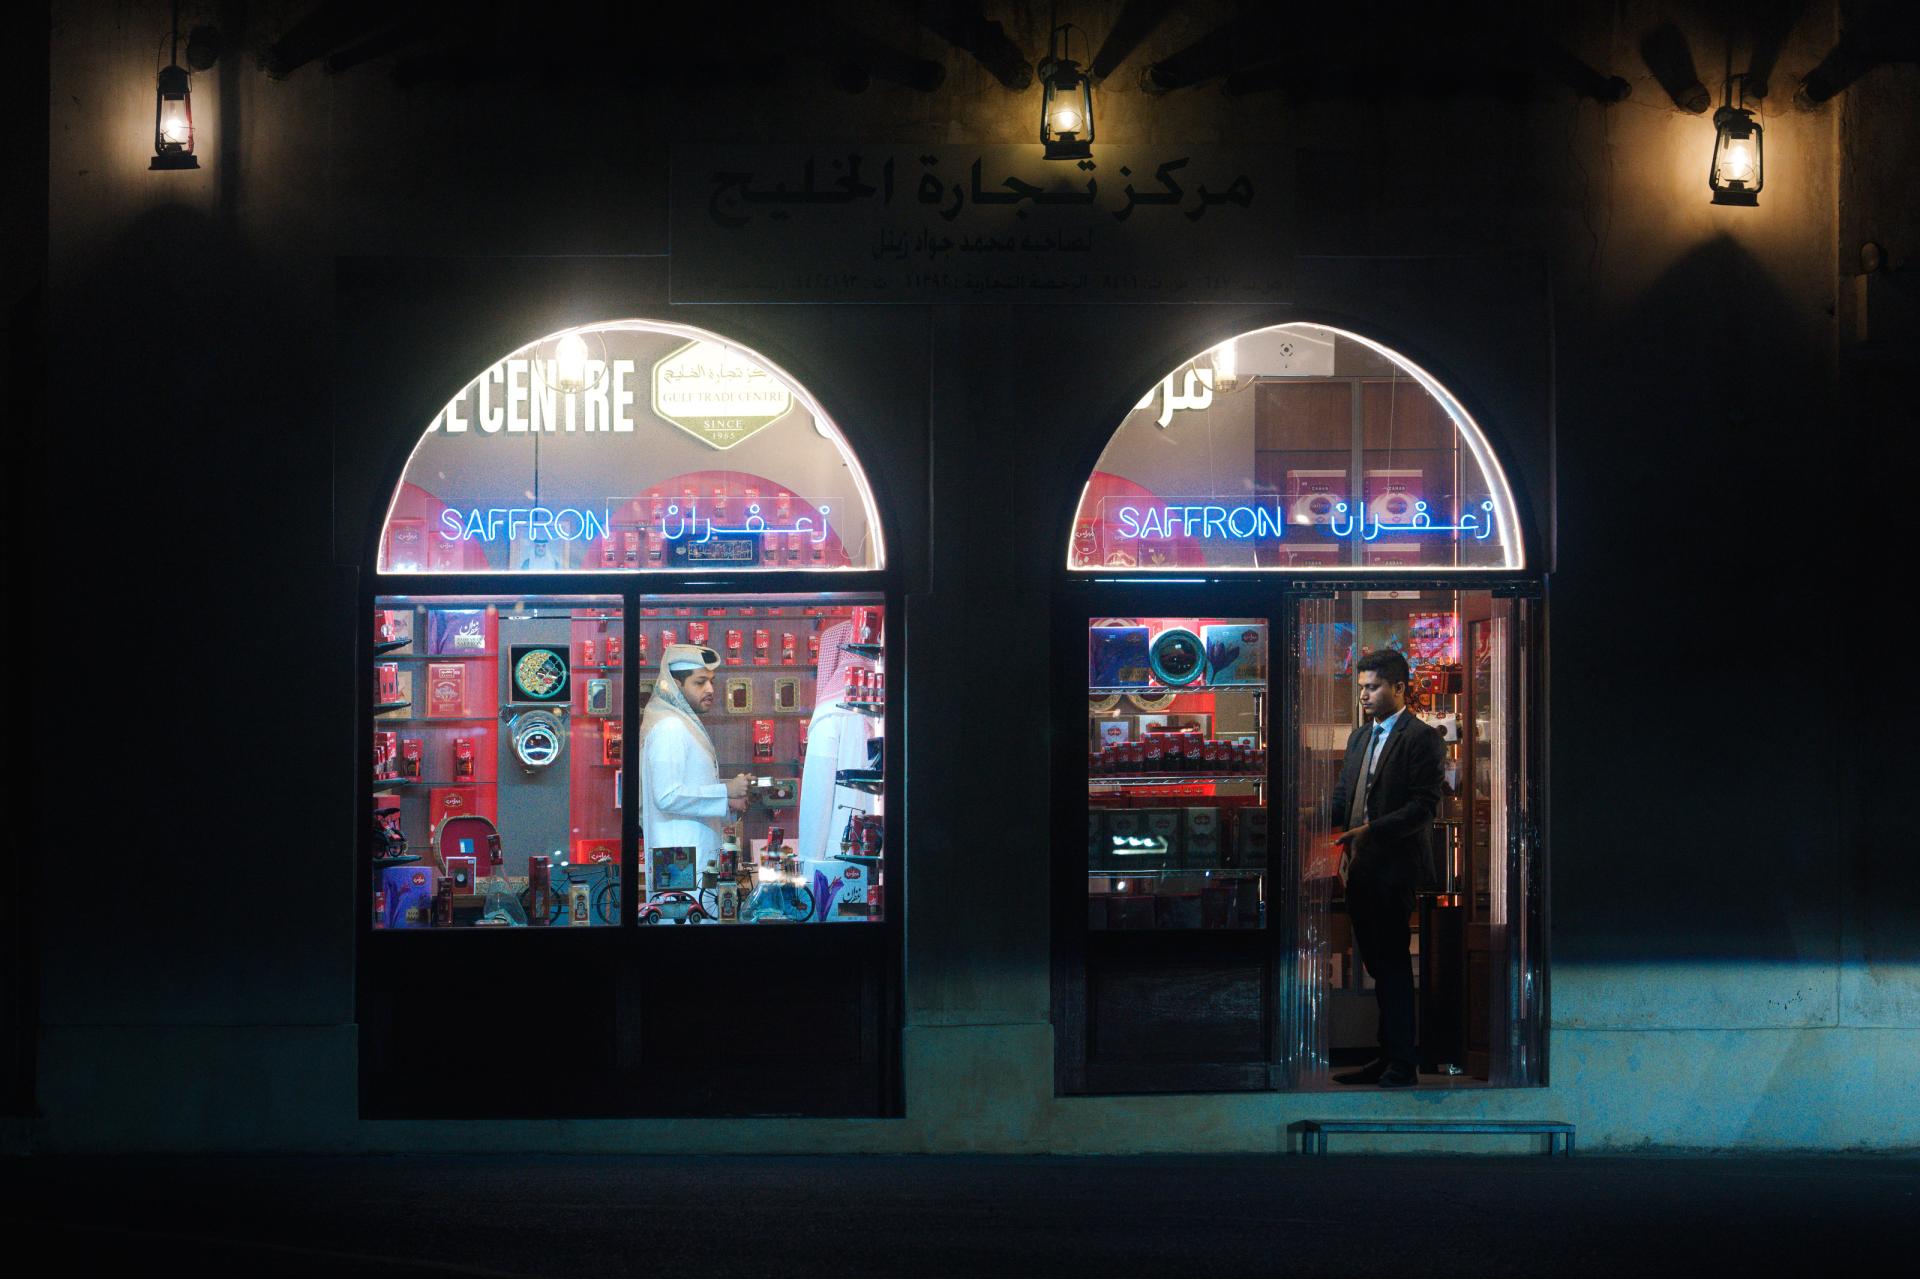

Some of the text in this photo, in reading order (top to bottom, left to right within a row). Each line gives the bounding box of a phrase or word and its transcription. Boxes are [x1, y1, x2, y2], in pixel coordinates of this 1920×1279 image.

[708, 153, 1255, 228] مركز تجارة الخليج
[914, 227, 955, 260] جواد
[959, 235, 1016, 253] محمد
[703, 419, 744, 429] SINCE
[440, 507, 610, 541] SAFFRON
[662, 503, 831, 544] زعفران
[1118, 506, 1282, 539] SAFFRON
[1330, 500, 1495, 541] زعفران
